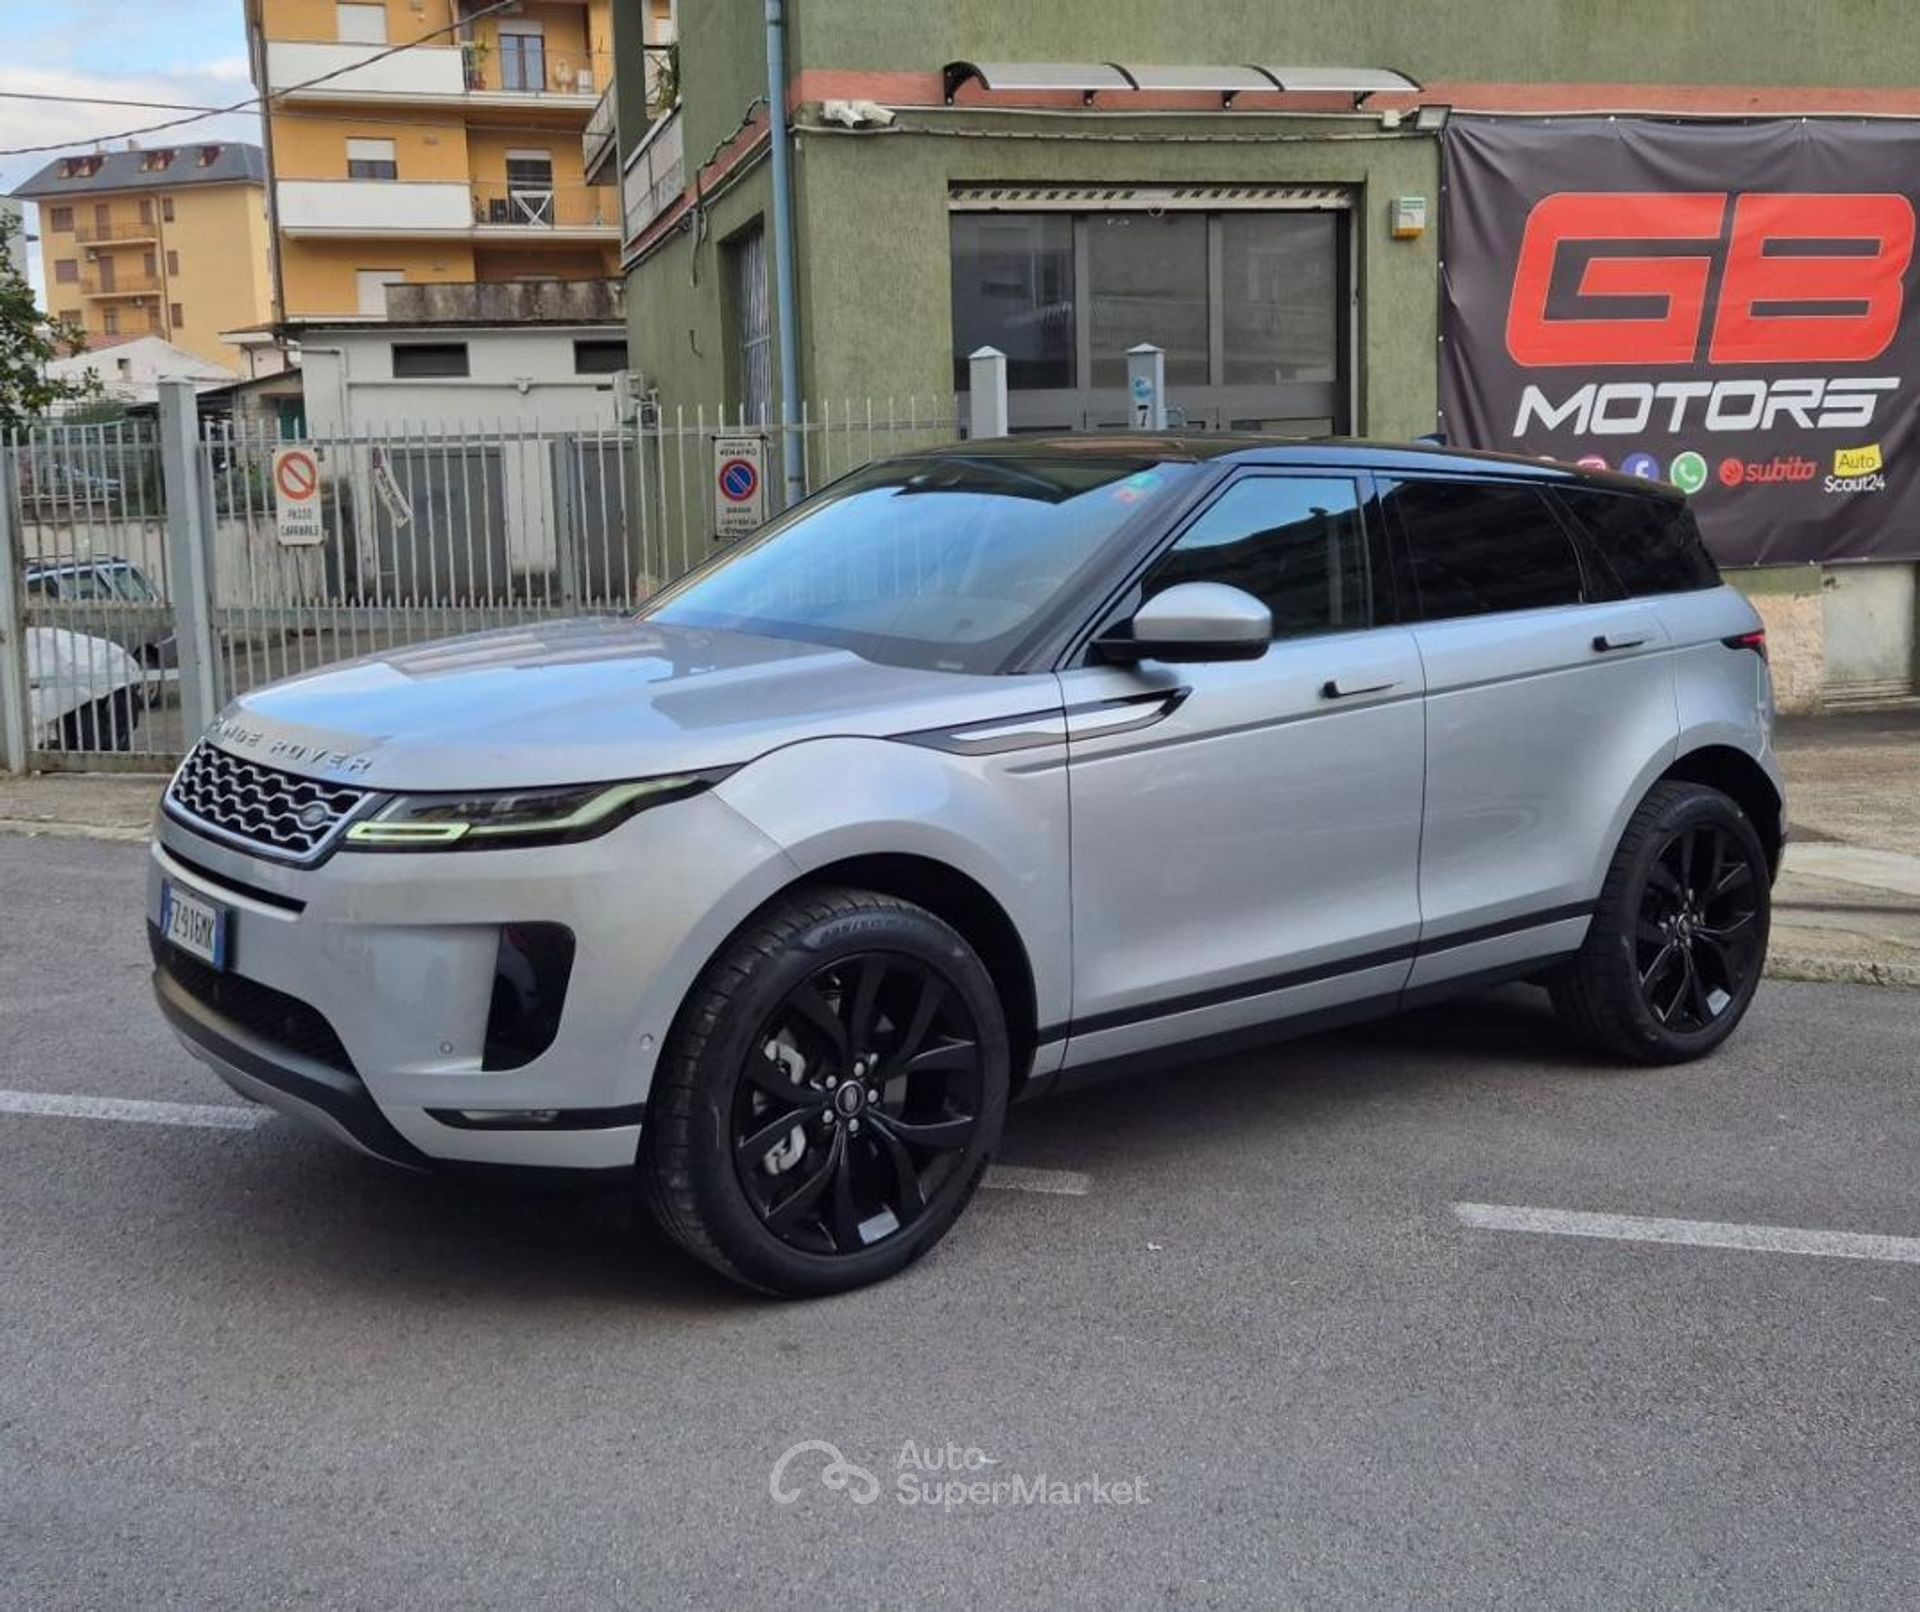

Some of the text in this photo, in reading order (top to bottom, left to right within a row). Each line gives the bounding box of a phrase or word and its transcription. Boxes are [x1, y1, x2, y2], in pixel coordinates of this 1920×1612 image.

[1505, 191, 1917, 367] GB
[1513, 377, 1900, 437] MOTORS
[1746, 456, 1818, 483] subito
[1838, 451, 1876, 470] Auto
[1823, 474, 1887, 493] Scout24
[269, 740, 374, 775] ROVER
